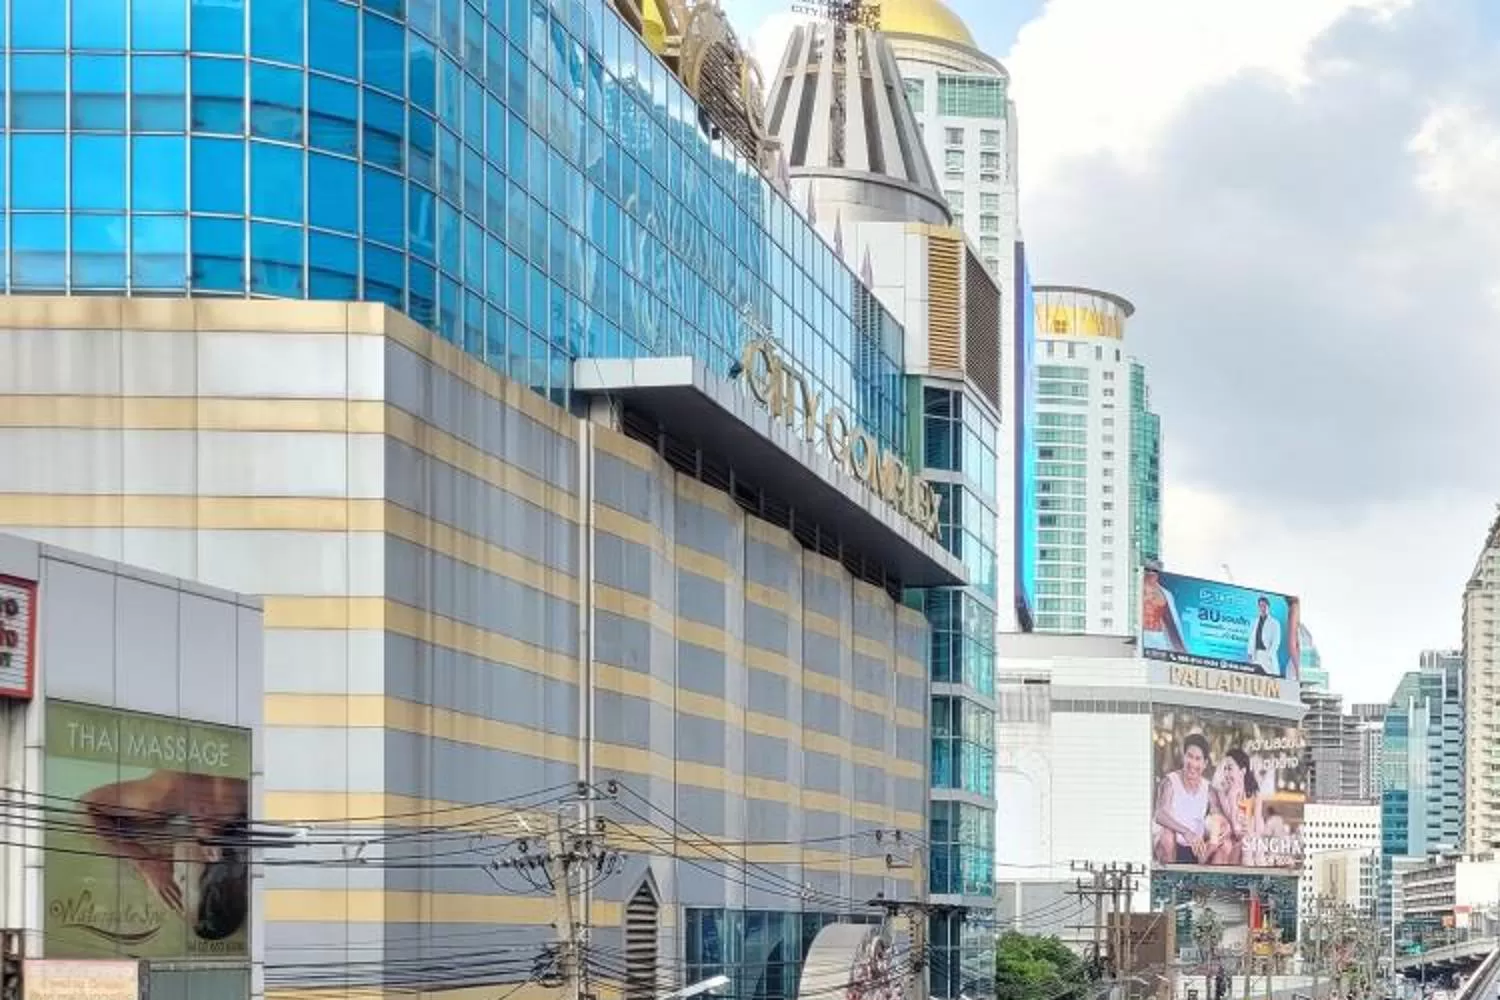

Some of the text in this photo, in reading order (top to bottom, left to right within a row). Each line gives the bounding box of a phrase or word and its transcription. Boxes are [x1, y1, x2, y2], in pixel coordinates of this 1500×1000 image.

[741, 340, 820, 443] CITY
[1169, 665, 1281, 699] PALLADIUM
[67, 720, 230, 768] THAI MASSAGE
[1241, 836, 1302, 854] SINGHA
